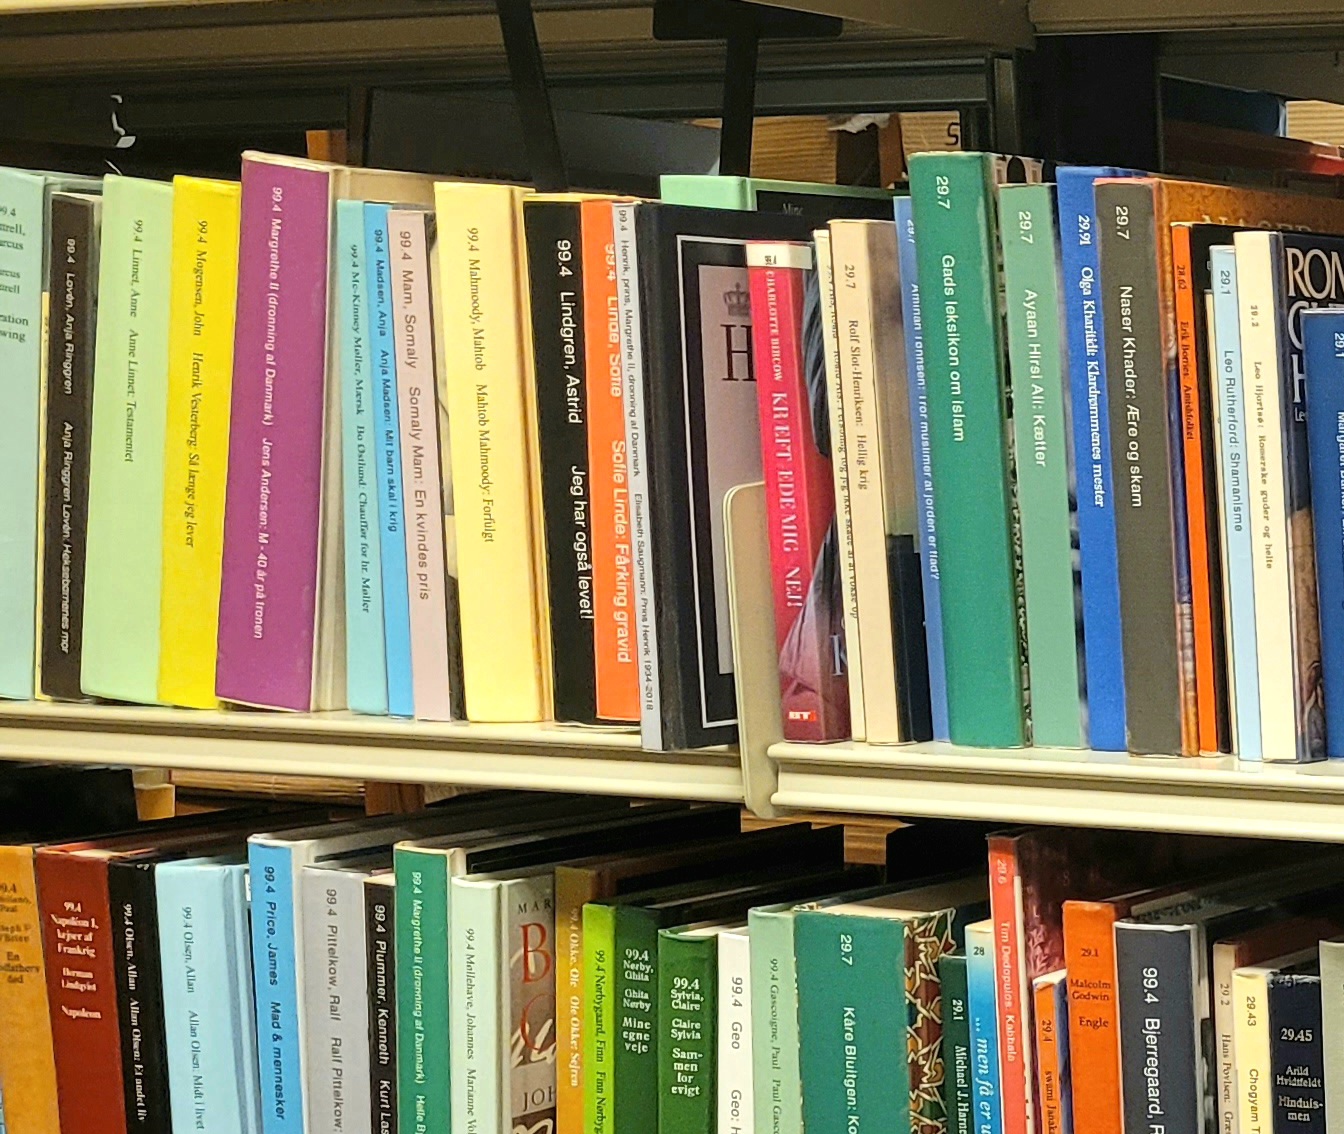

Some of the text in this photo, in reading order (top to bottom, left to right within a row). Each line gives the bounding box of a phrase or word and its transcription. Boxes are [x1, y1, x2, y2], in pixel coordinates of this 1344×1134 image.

[466, 227, 497, 543] 99.4 Mahmoody, Mahtob Mahtob Mahmoody: Forfulgt
[556, 239, 593, 619] 99.4 Lindgren, Astrid Jeg har også levet!
[935, 175, 966, 442] 29.7 Gads leksikon om islam
[1141, 1017, 1164, 1119] Bjerregaard,
[1142, 967, 1159, 1004] 99.4
